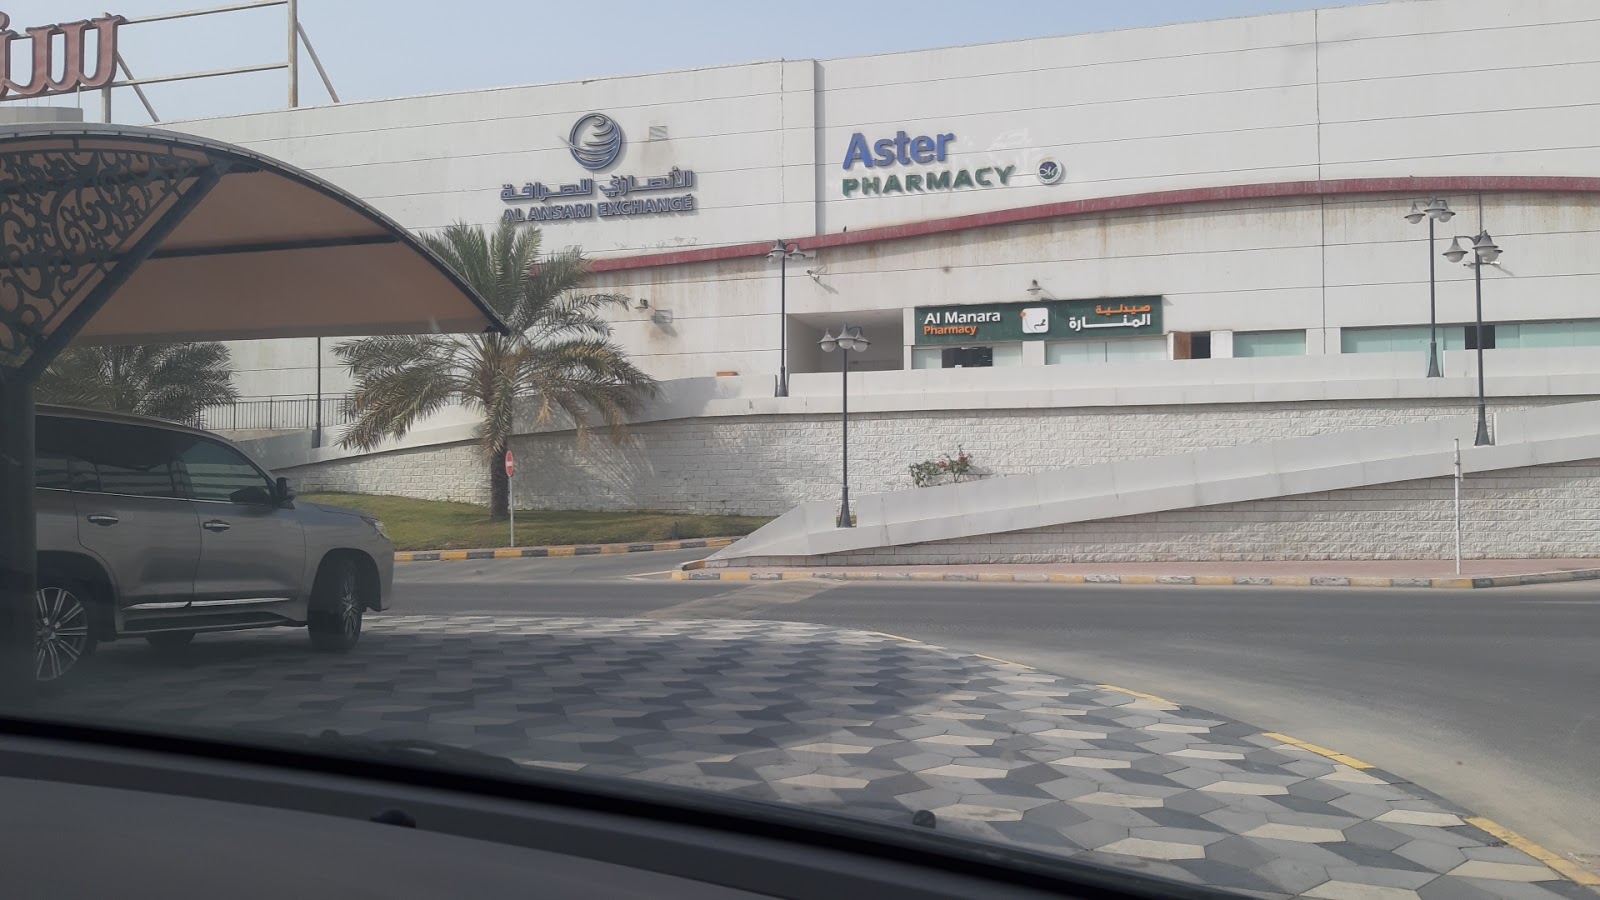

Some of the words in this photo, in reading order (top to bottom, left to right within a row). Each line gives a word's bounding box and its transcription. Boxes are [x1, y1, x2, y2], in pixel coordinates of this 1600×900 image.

[842, 131, 955, 169] Aster
[500, 178, 593, 202] للصرافة
[842, 165, 1016, 197] PHARMACY
[503, 208, 526, 222] AL
[527, 203, 592, 222] ANSARI
[597, 195, 694, 217] EXCHANGE
[924, 312, 940, 325] Al
[944, 311, 1001, 324] Manara
[1095, 304, 1151, 316] صيدلية
[923, 325, 977, 336] Pharmacy
[1068, 313, 1151, 332] المنارة
